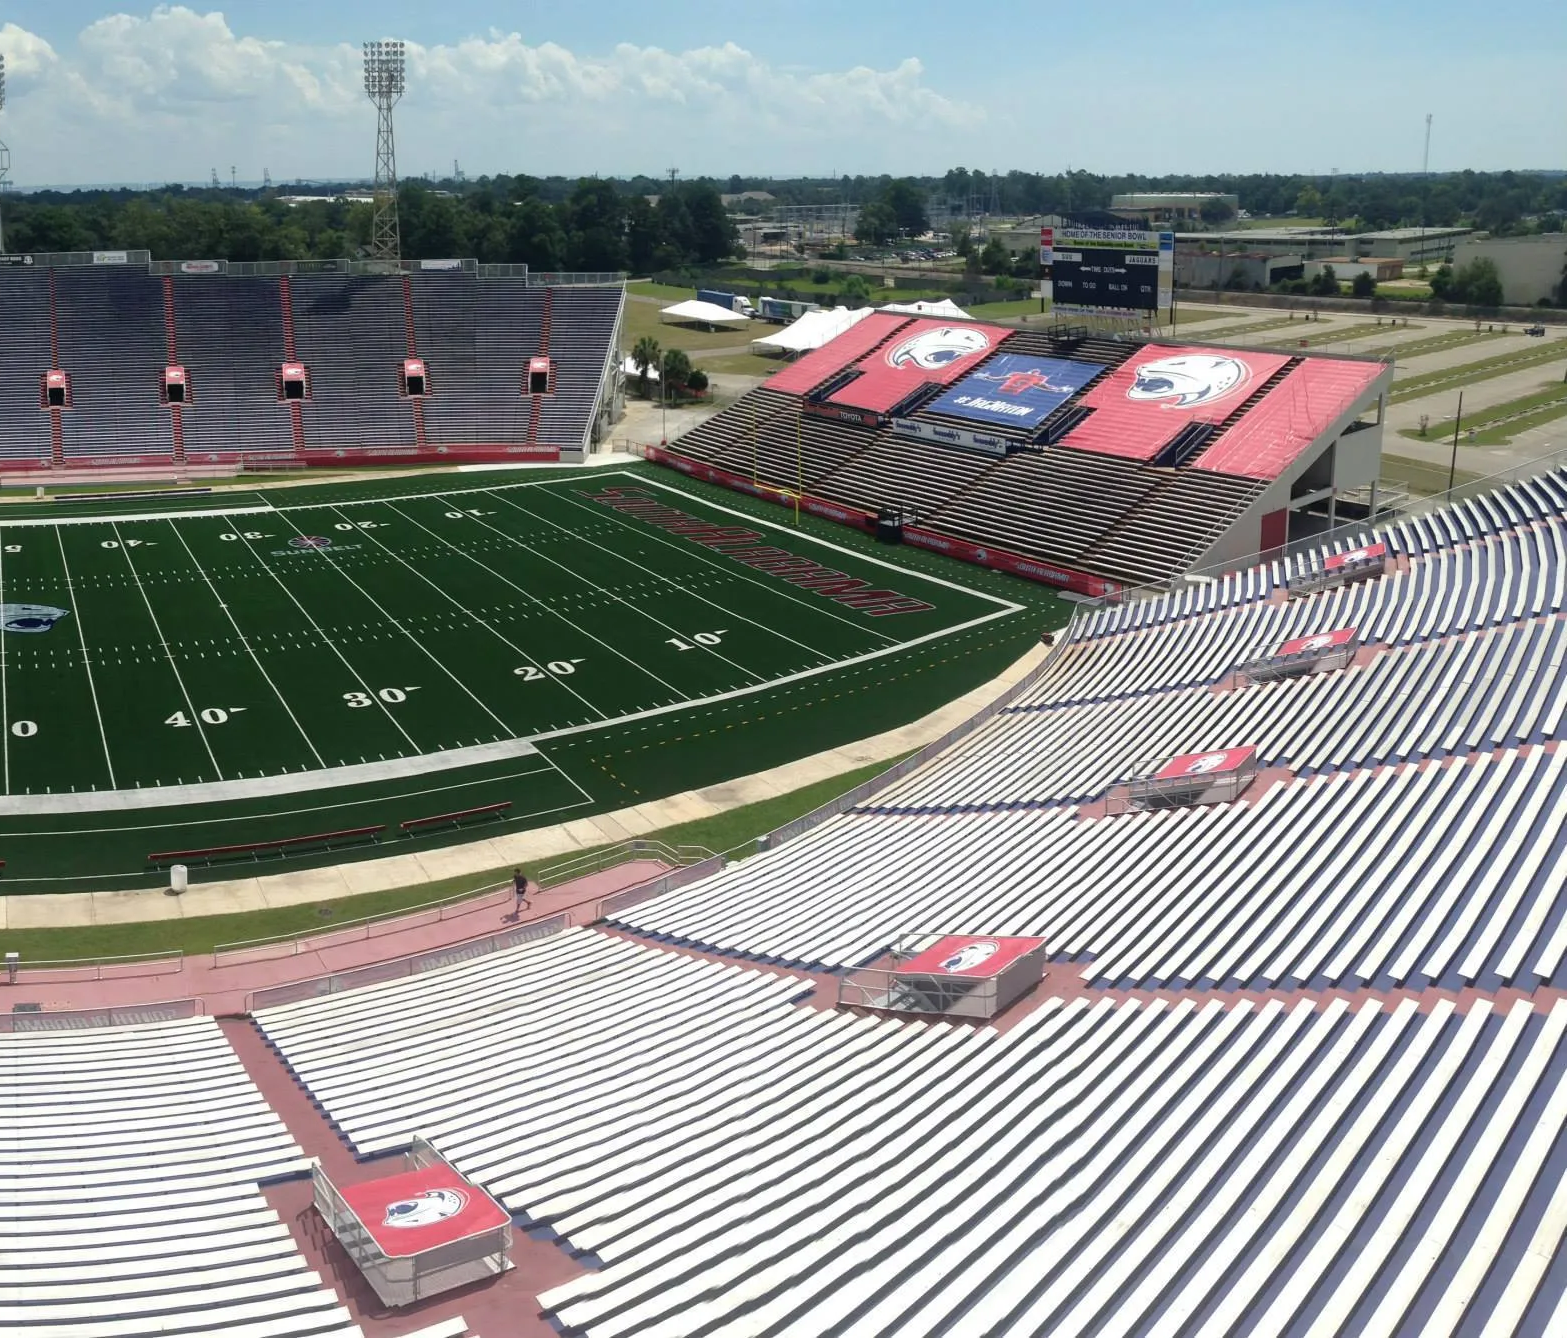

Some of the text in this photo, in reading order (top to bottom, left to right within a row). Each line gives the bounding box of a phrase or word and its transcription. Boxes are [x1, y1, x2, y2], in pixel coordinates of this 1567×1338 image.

[1062, 231, 1147, 240] HOME OF THE SENIOR BOWL
[1129, 256, 1156, 264] JAGUARS
[840, 411, 862, 423] TOYOTA
[445, 509, 484, 519] 10
[334, 520, 379, 531] 20
[219, 531, 264, 542] 30
[100, 539, 144, 549] 40
[271, 548, 315, 557] SUN
[665, 632, 722, 652] 10
[513, 660, 578, 682] 20
[342, 686, 407, 708] 30
[163, 708, 229, 727] 40
